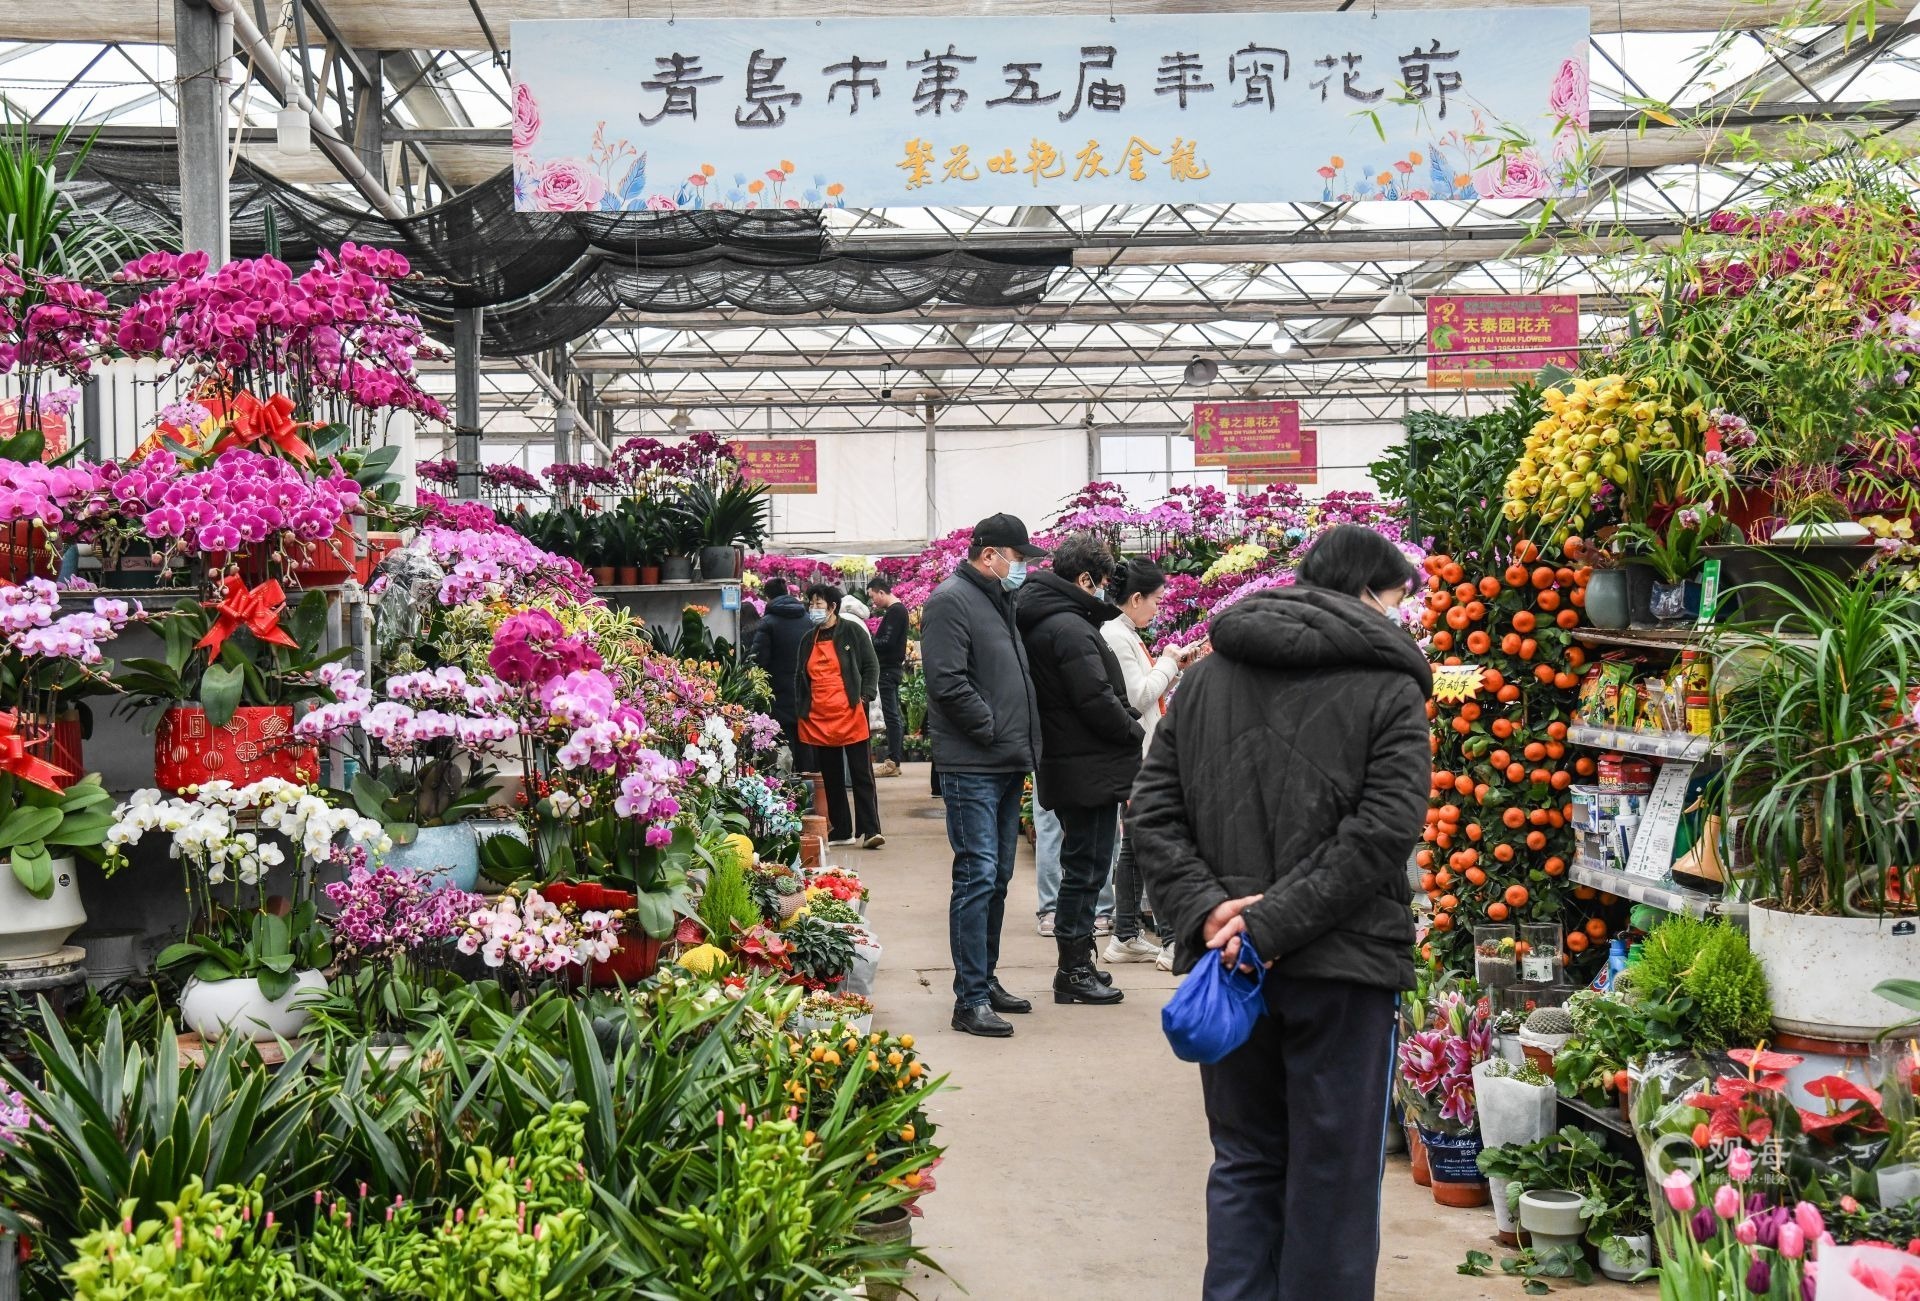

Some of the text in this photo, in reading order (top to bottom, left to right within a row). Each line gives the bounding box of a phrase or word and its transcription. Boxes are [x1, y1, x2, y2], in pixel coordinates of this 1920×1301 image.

[1463, 317, 1552, 333] 天泰园花卉
[1517, 335, 1552, 343] FLOWERS
